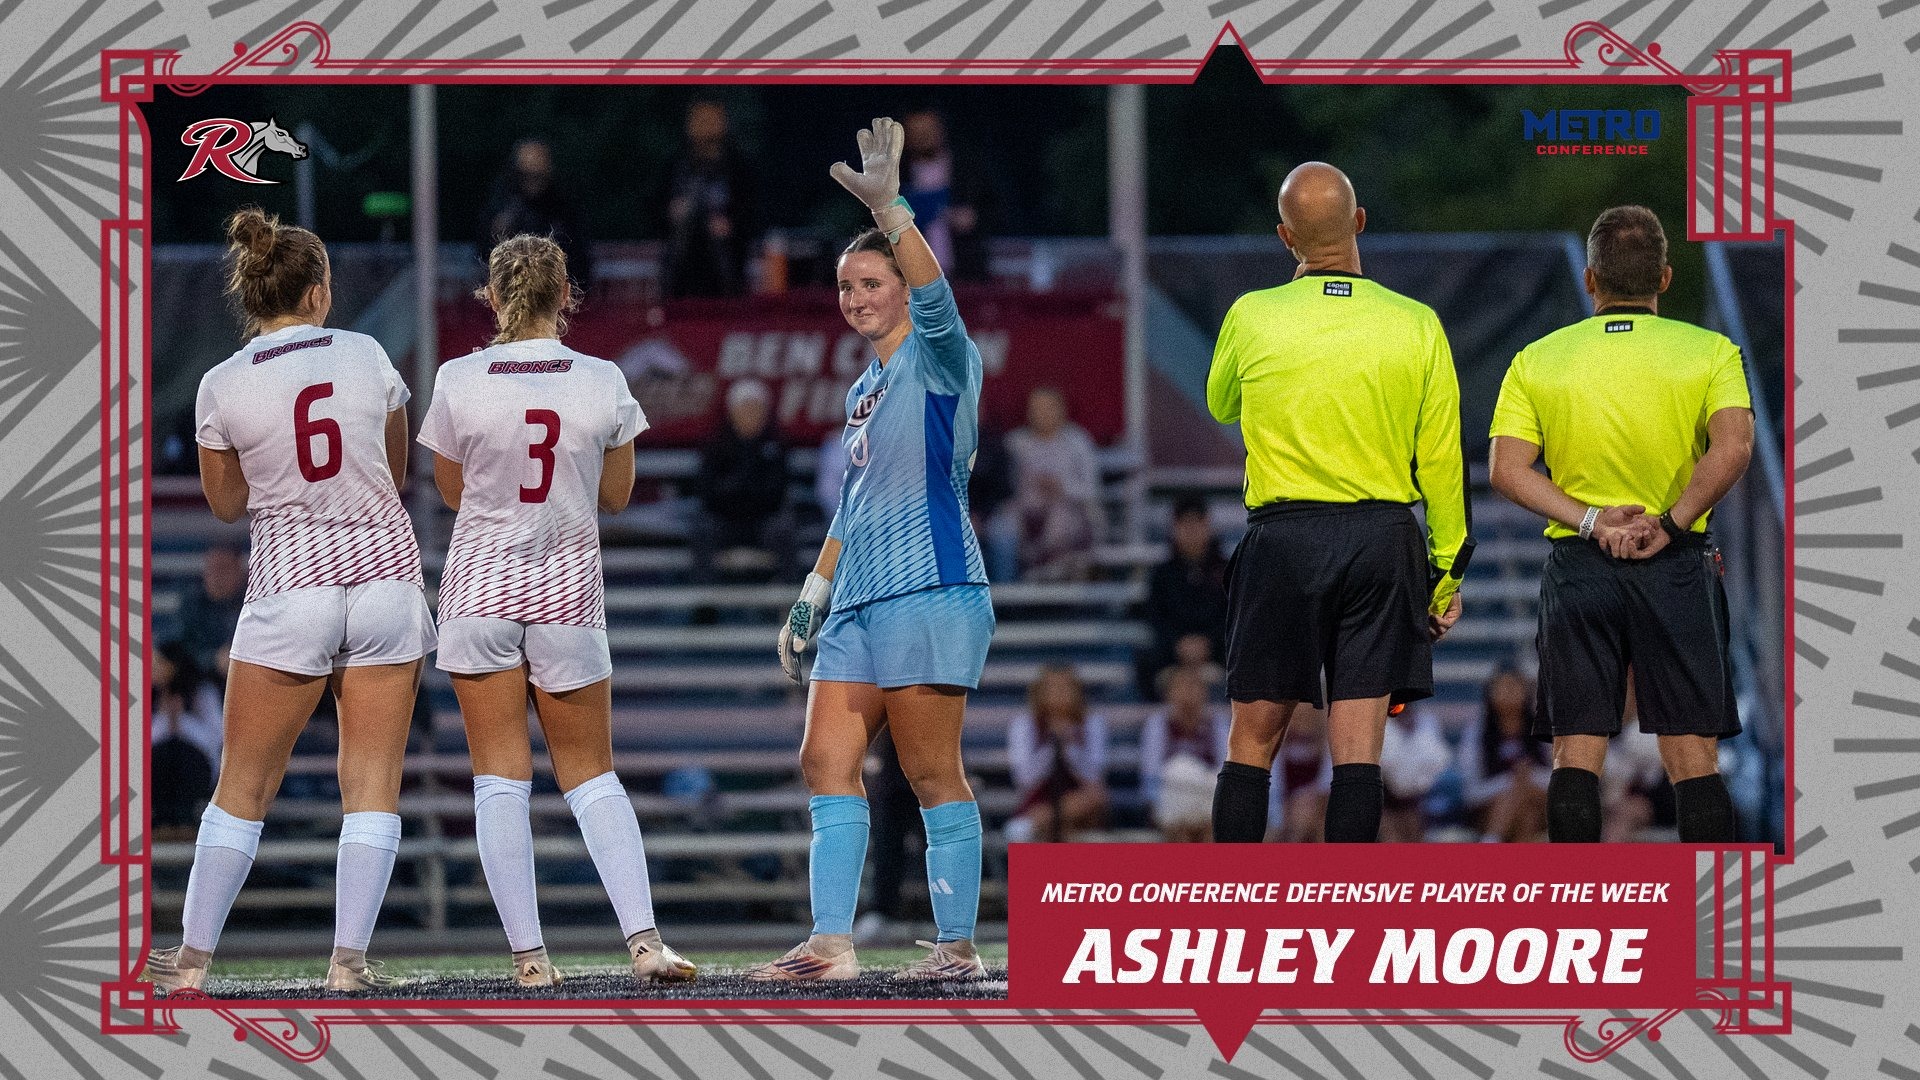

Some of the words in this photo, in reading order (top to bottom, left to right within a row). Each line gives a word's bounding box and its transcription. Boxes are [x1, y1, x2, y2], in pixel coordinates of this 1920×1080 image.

[252, 335, 333, 365] BRONCS
[488, 360, 573, 375] BRONCS
[294, 381, 343, 483] 6
[519, 408, 561, 504] 3
